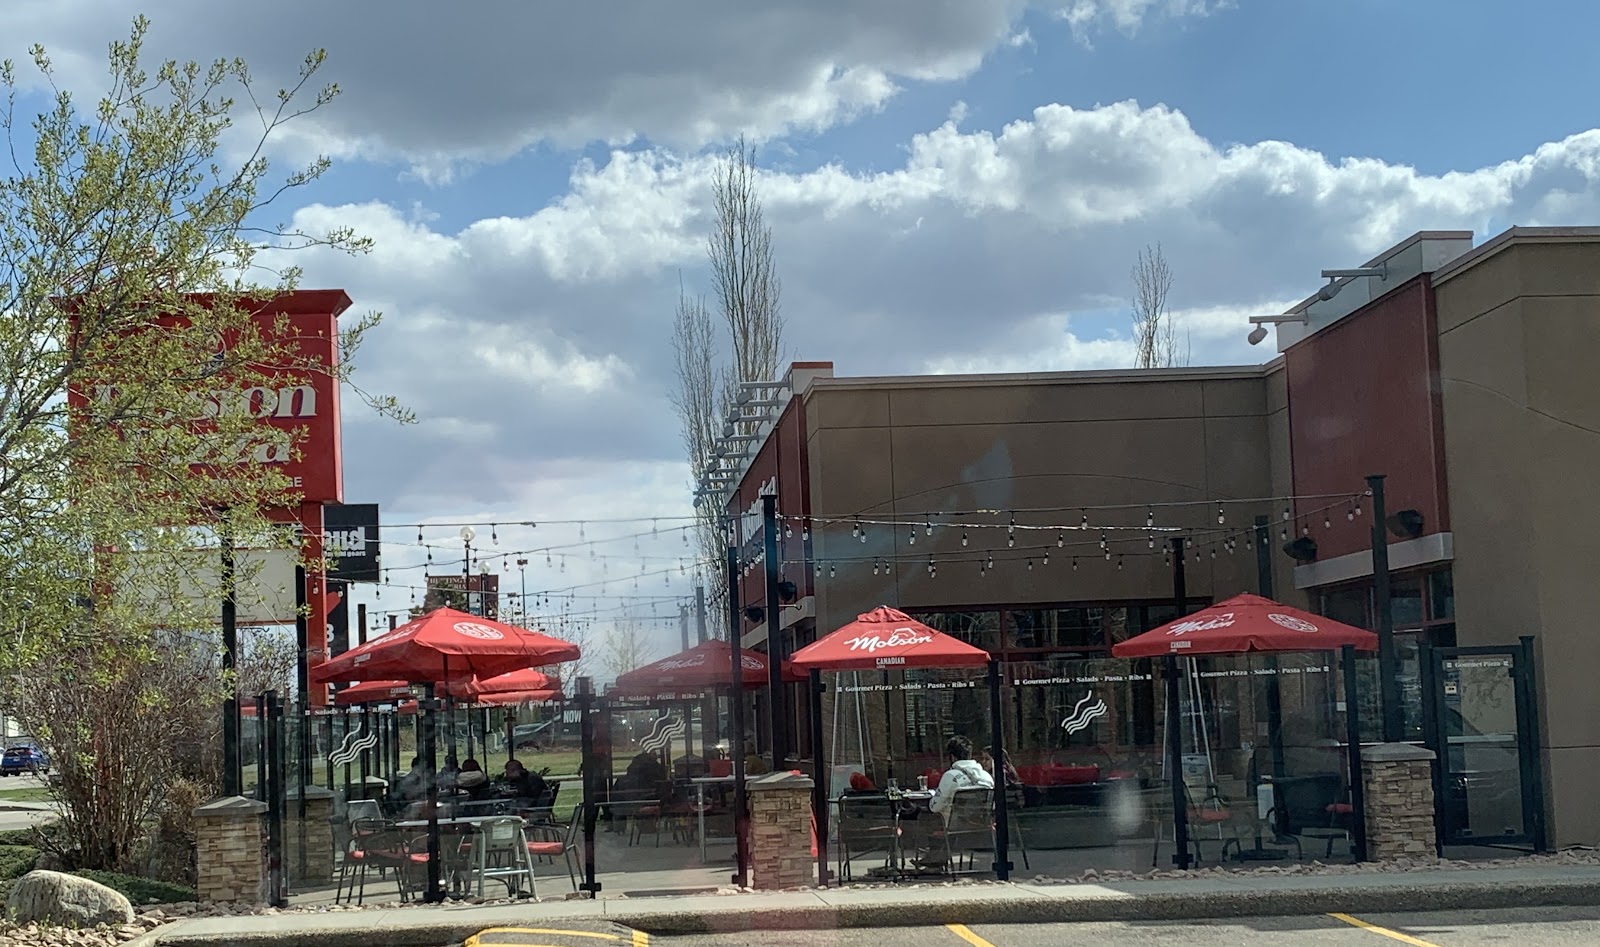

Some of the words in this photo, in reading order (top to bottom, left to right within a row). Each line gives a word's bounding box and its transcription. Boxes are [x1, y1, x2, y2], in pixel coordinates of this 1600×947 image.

[844, 635, 934, 653] Molson
[876, 657, 906, 665] CANADIAN
[1200, 670, 1229, 678] Gourmet
[1230, 669, 1248, 677] Pizza
[845, 685, 874, 693] Gourmet
[314, 707, 339, 715] Salads
